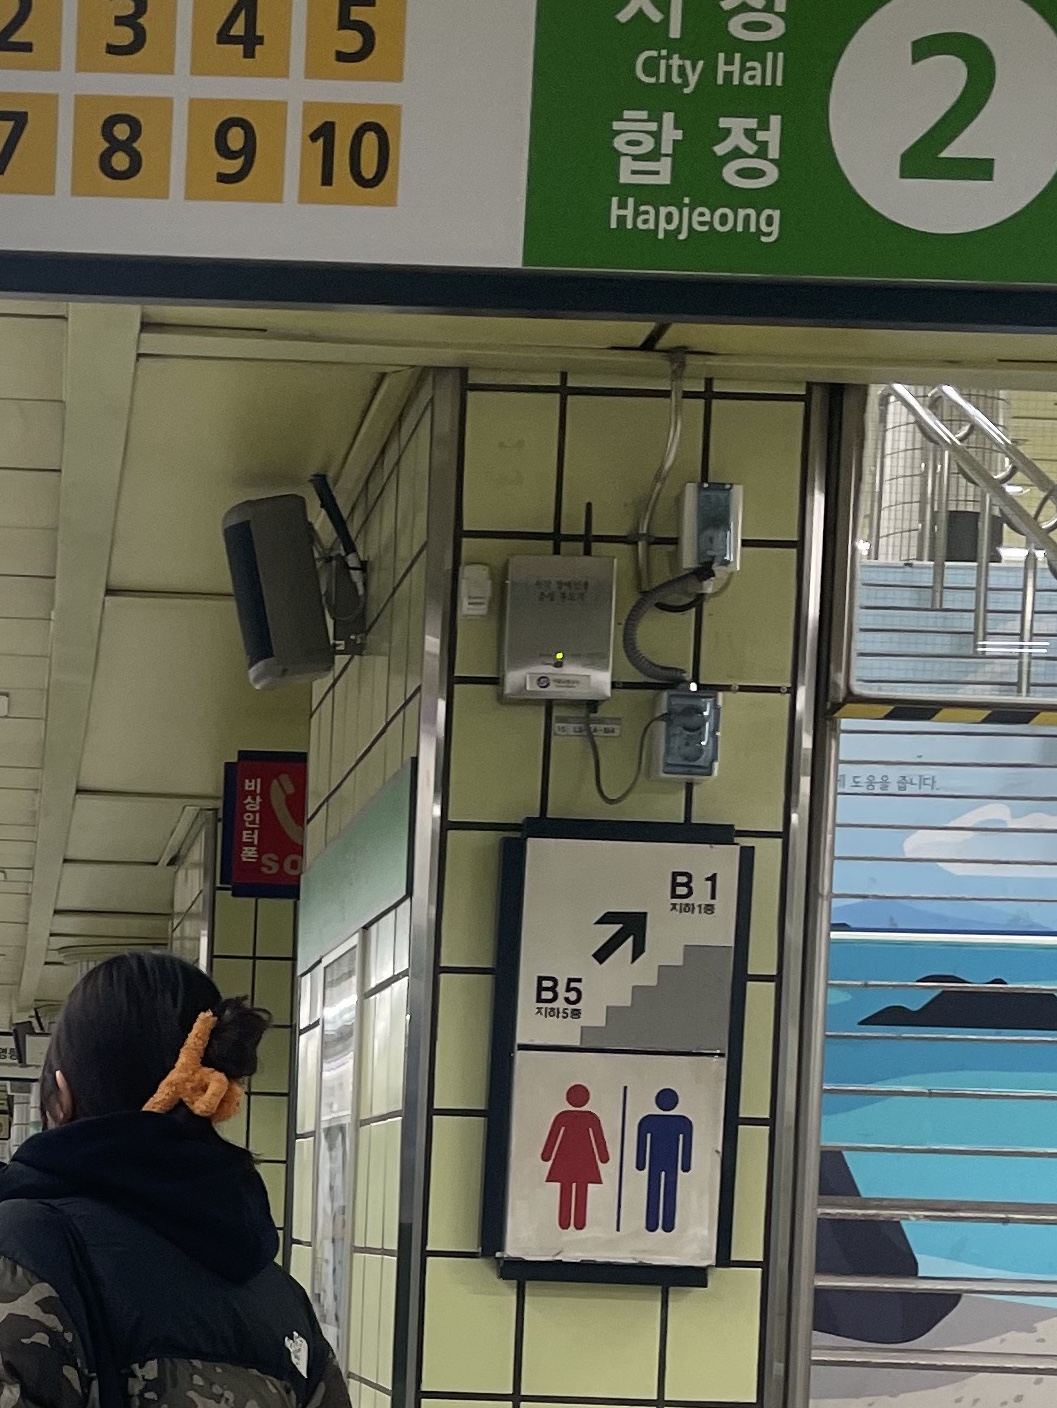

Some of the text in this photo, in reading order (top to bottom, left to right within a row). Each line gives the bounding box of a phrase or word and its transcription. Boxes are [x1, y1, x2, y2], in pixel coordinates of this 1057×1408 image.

[104, 0, 147, 56] 3
[215, 0, 264, 59] 4
[334, 0, 376, 63] 5
[635, 50, 785, 93] City Hall
[898, 31, 997, 182] 2
[98, 113, 143, 181] 8
[214, 117, 257, 184] 9
[308, 120, 390, 189] 10
[610, 197, 781, 243] Hapjeong
[850, 775, 892, 791] 도움을
[669, 902, 716, 915] 지하1층
[535, 975, 583, 1006] B5
[535, 1006, 582, 1020] 지하5층
